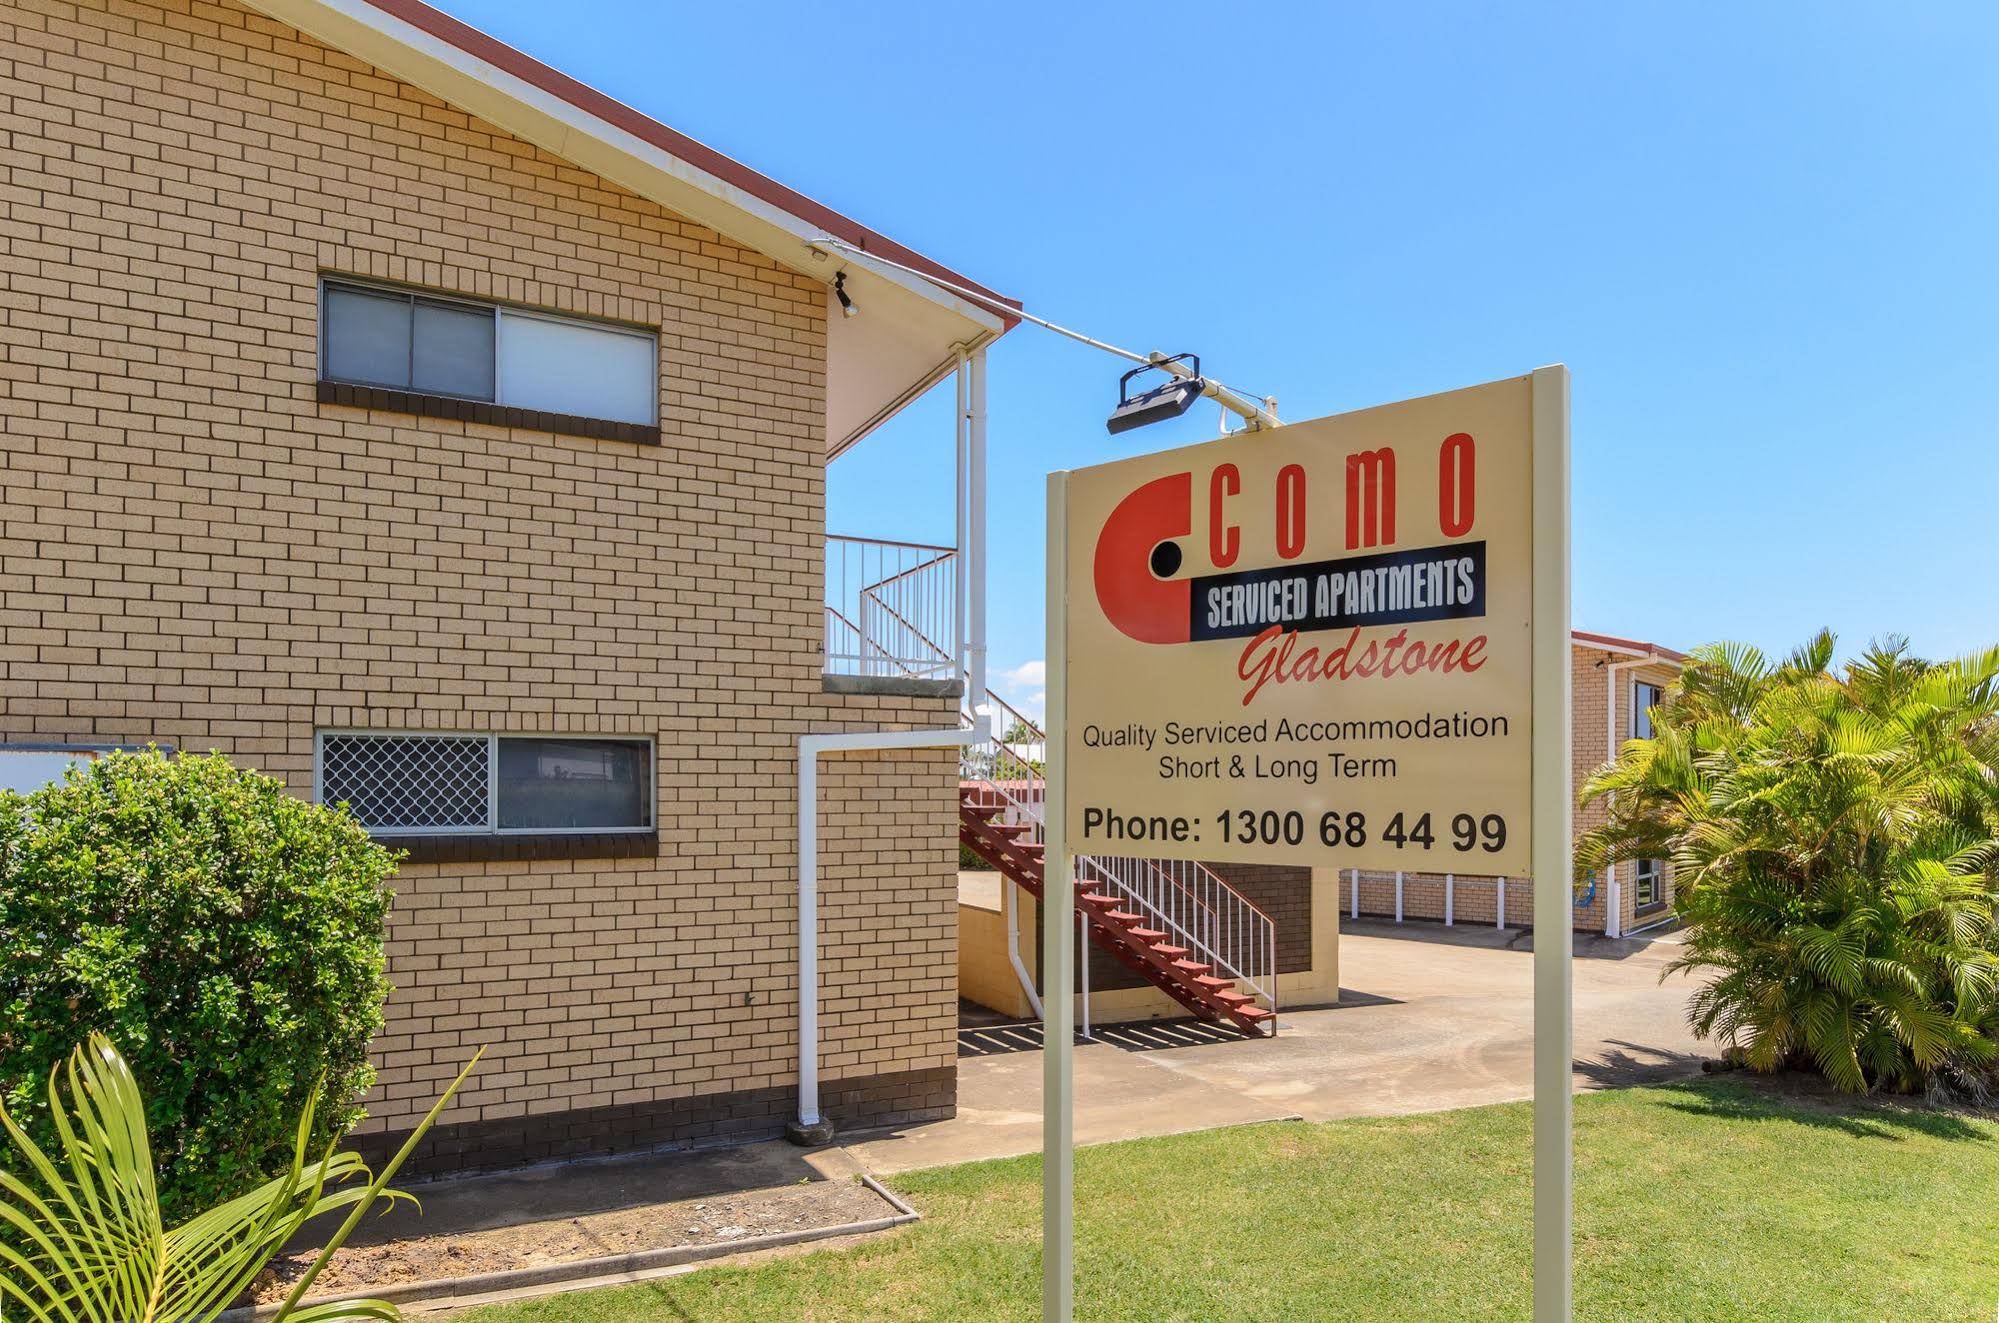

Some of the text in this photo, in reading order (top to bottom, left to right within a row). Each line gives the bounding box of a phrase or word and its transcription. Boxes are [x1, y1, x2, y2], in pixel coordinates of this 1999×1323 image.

[1207, 557, 1474, 629] SERVICED APARTMENTS
[1237, 624, 1488, 707] Gladstone
[1083, 711, 1509, 751] Quality Serviced Accommodation
[1158, 753, 1397, 784] Short & Long Term
[1083, 807, 1507, 853] Phone: 1300 68 44 99
